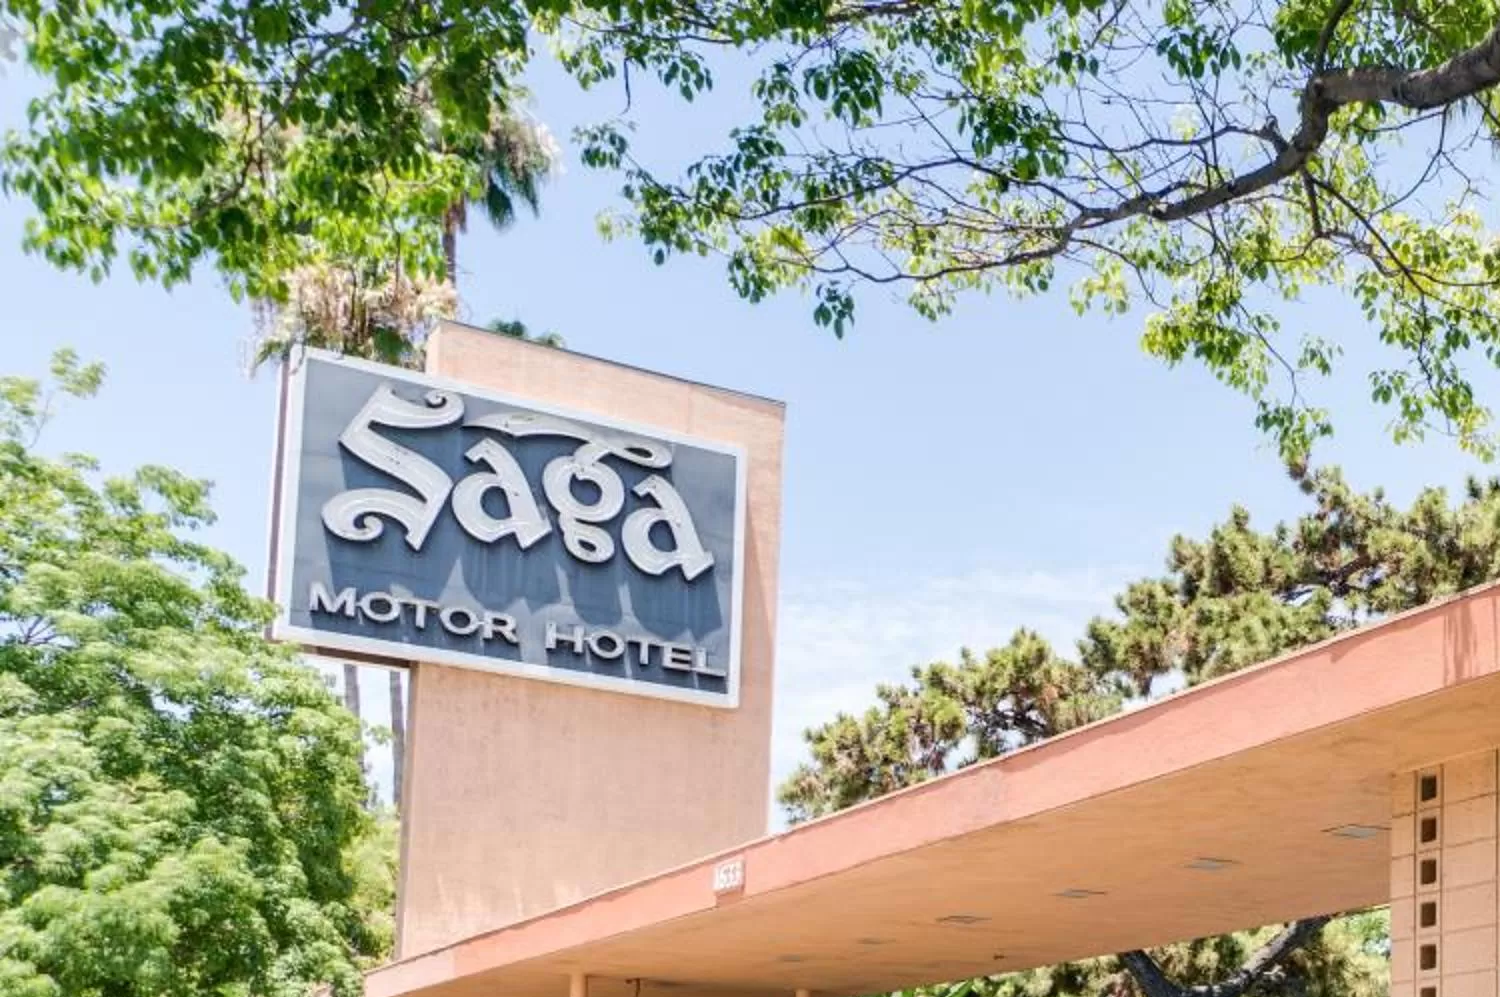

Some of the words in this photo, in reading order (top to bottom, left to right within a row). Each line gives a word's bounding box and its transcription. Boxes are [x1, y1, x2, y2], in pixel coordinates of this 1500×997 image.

[321, 383, 715, 582] Saga
[309, 582, 519, 644] MOTOR
[545, 621, 727, 677] HOTEL
